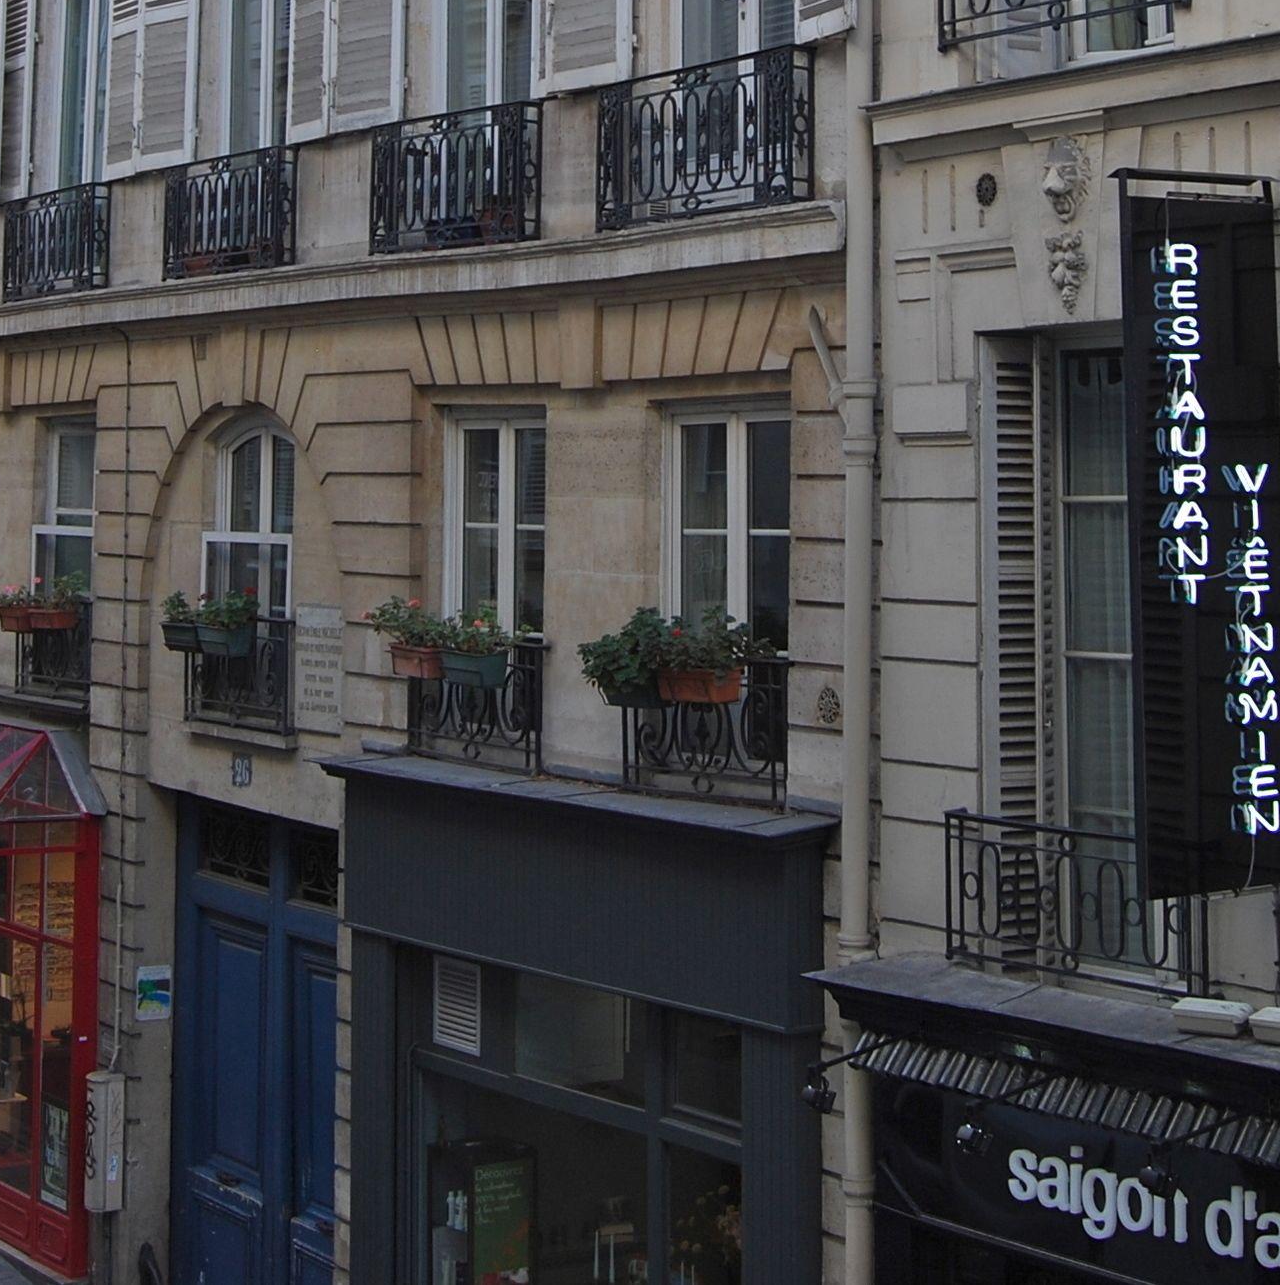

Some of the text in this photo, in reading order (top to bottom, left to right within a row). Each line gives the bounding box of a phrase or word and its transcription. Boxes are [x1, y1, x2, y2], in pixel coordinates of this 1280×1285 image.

[1169, 242, 1209, 604] RESTAURANT
[234, 757, 251, 785] 26
[1007, 1145, 1189, 1244] saigon
